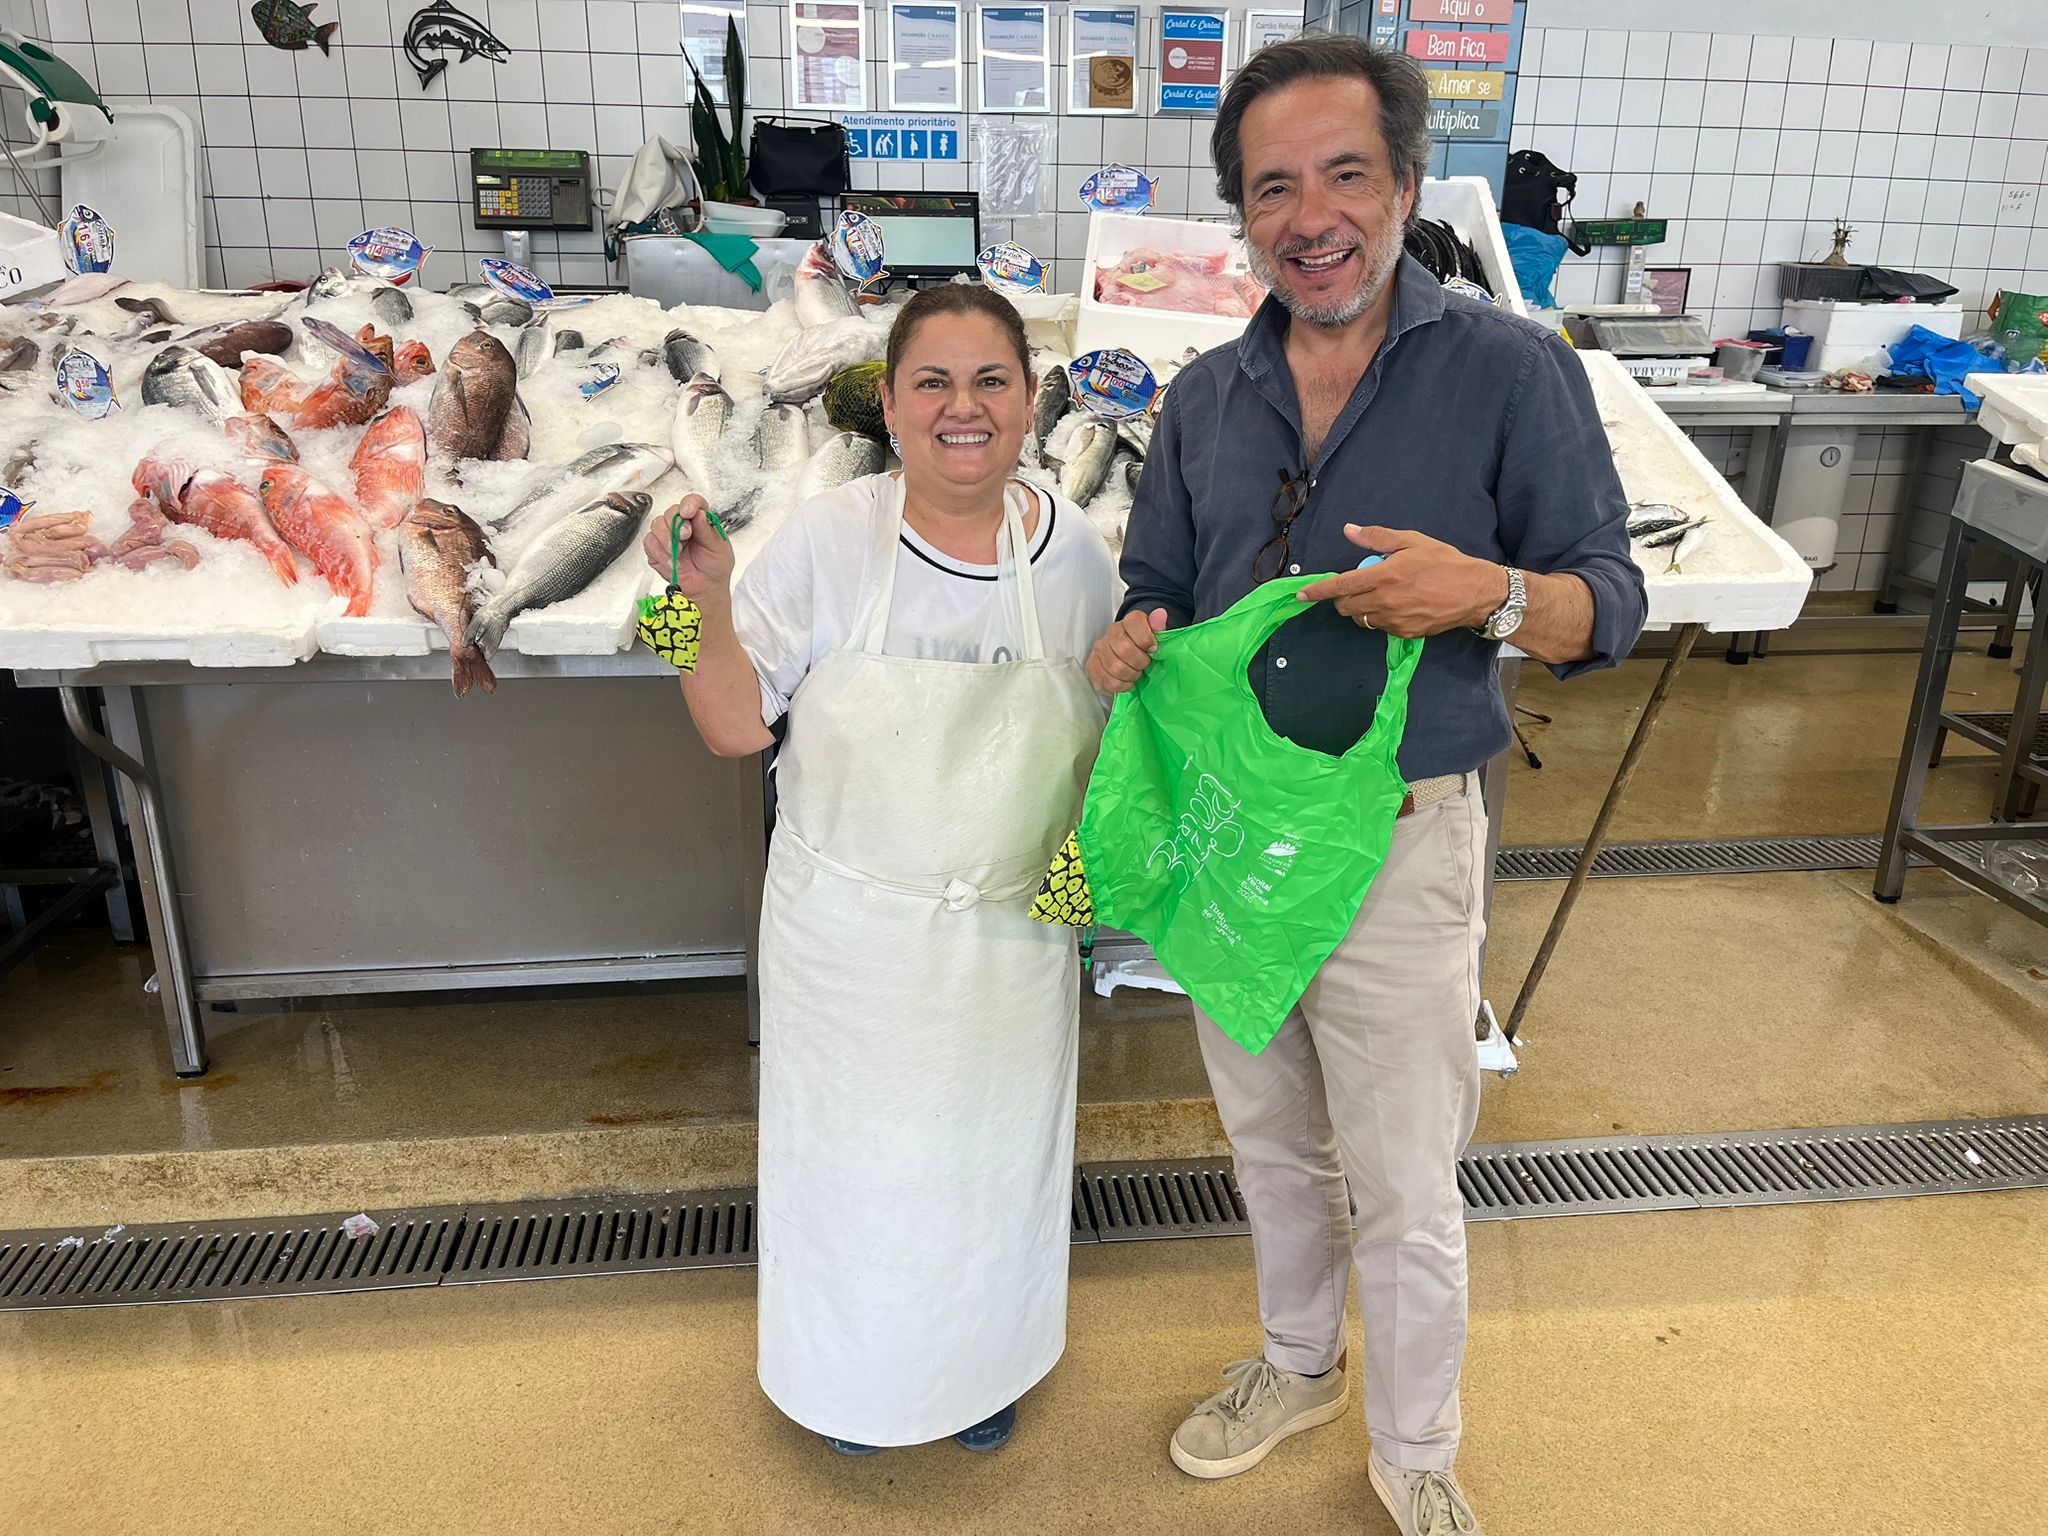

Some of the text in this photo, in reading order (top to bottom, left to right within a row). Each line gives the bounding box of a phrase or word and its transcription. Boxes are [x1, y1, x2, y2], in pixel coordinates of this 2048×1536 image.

[1440, 0, 1485, 20] Aqui o
[1427, 34, 1487, 60] Bem Fica,
[1438, 73, 1476, 95] Amor
[1477, 84, 1491, 95] se
[842, 115, 956, 128] Atendimento prioritário
[1426, 109, 1480, 135] ultiplica
